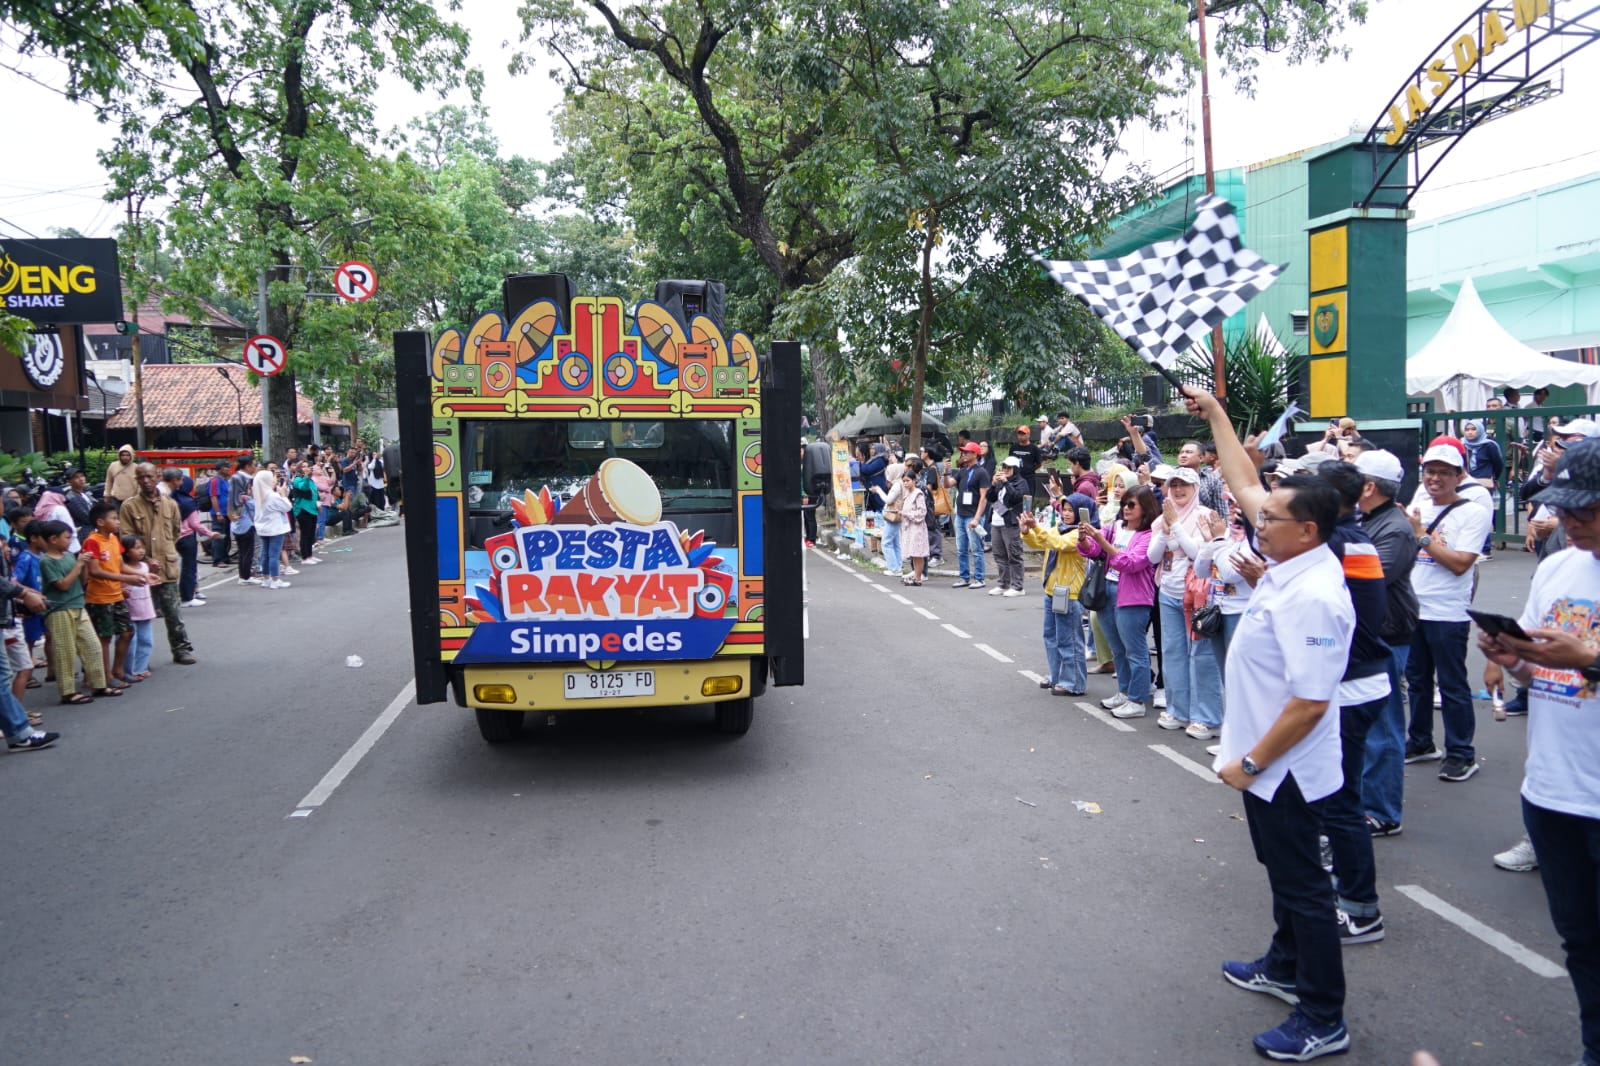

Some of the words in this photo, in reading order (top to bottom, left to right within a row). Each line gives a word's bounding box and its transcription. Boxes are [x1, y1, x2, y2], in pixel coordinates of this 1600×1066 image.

[349, 270, 367, 294] P
[7, 295, 65, 308] SHAKE
[258, 343, 276, 368] P
[522, 527, 683, 572] PESTA
[506, 572, 699, 617] RAKYAT
[510, 625, 683, 660] Simpedes
[567, 674, 576, 690] D
[590, 673, 624, 689] 8125
[636, 672, 652, 687] FD
